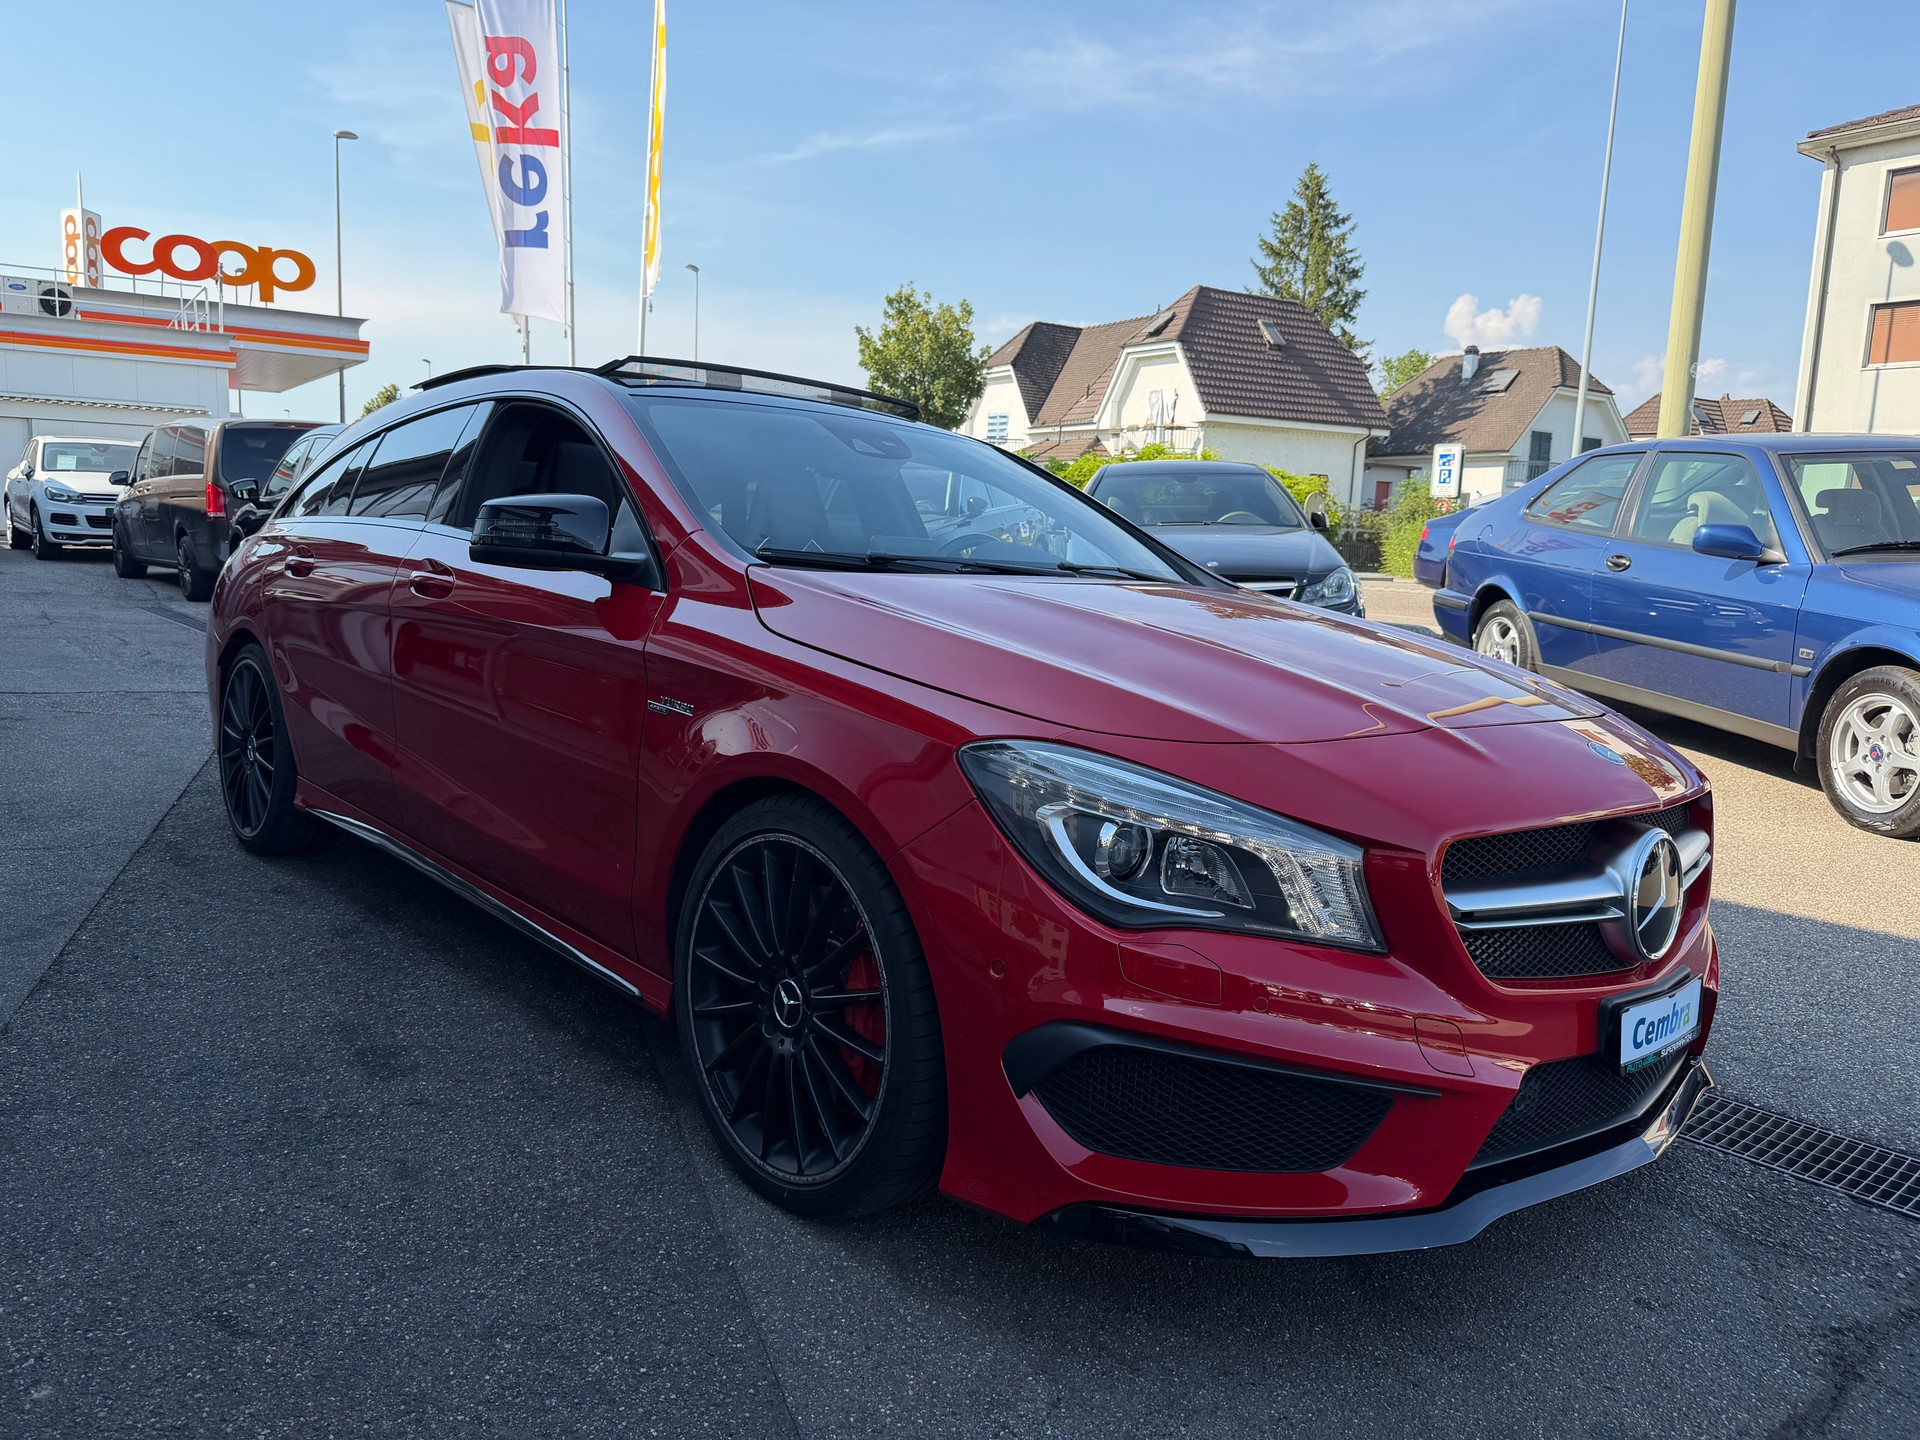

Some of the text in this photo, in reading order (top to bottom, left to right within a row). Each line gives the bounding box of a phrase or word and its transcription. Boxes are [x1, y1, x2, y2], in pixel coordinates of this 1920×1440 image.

[64, 214, 81, 287] oop
[86, 216, 100, 288] oop
[100, 226, 316, 303] coop
[1632, 1001, 1692, 1050] Cembra
